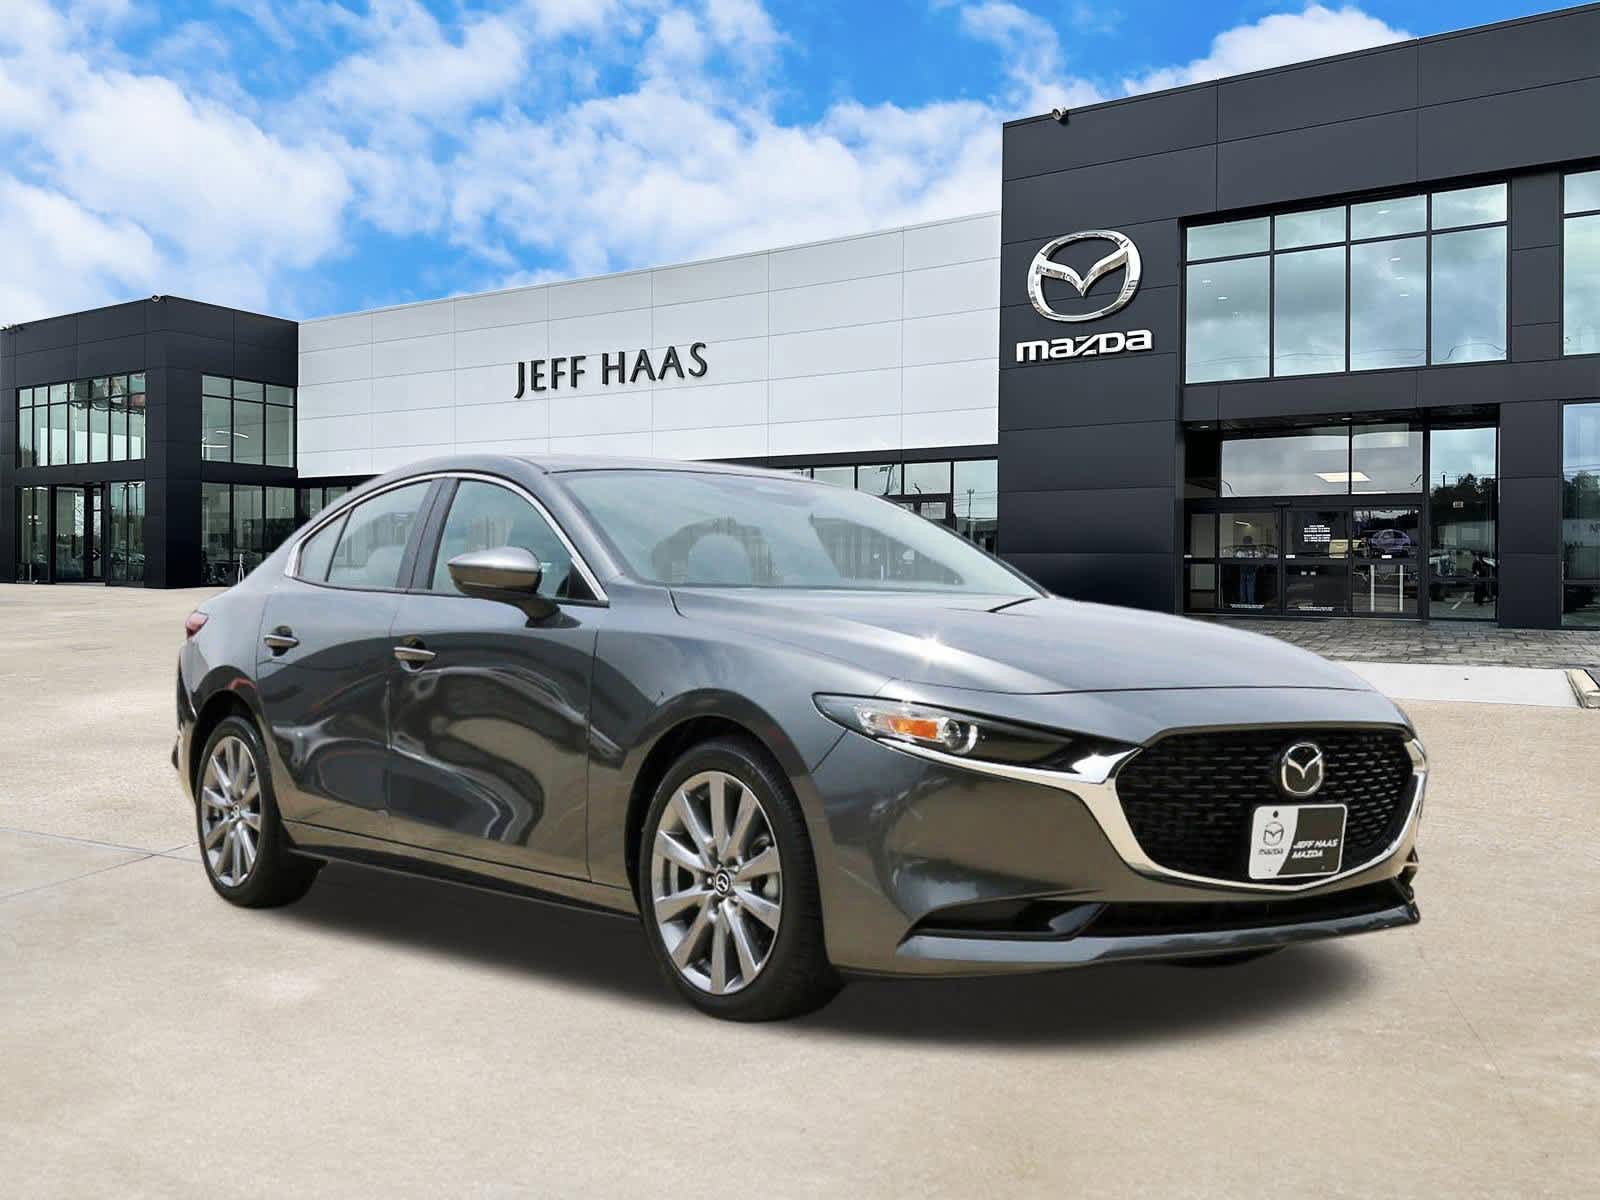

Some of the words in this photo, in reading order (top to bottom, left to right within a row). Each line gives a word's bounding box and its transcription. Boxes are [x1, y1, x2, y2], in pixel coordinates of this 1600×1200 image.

[514, 355, 587, 399] JEFF
[601, 342, 708, 385] HAAS
[1293, 840, 1314, 849] JEFF
[1315, 838, 1339, 848] HAAS
[1292, 849, 1323, 859] MAZDA
